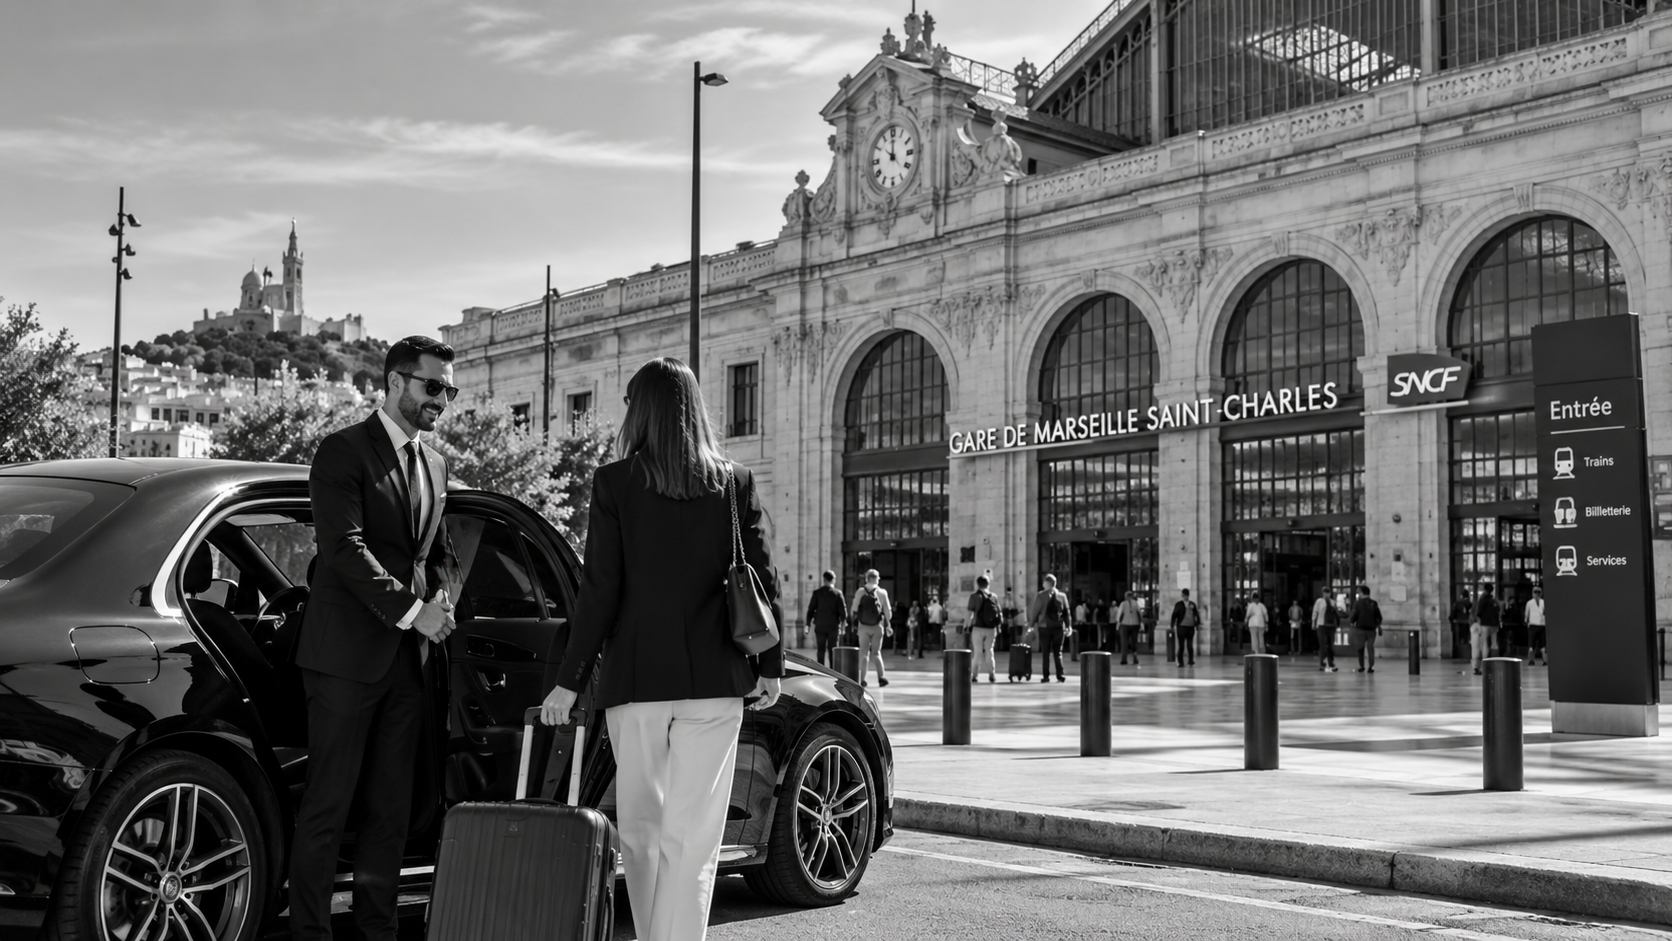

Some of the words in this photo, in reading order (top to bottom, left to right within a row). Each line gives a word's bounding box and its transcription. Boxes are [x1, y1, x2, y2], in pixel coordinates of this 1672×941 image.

[1390, 366, 1463, 398] SNCF
[948, 427, 998, 455] GARE
[1003, 425, 1028, 449] DE
[1033, 408, 1139, 445] MARSEILLE
[1146, 381, 1338, 432] SAINT-CHARLES
[1550, 395, 1613, 421] Entrée
[1583, 455, 1615, 468] Trains
[1586, 554, 1627, 567] Services
